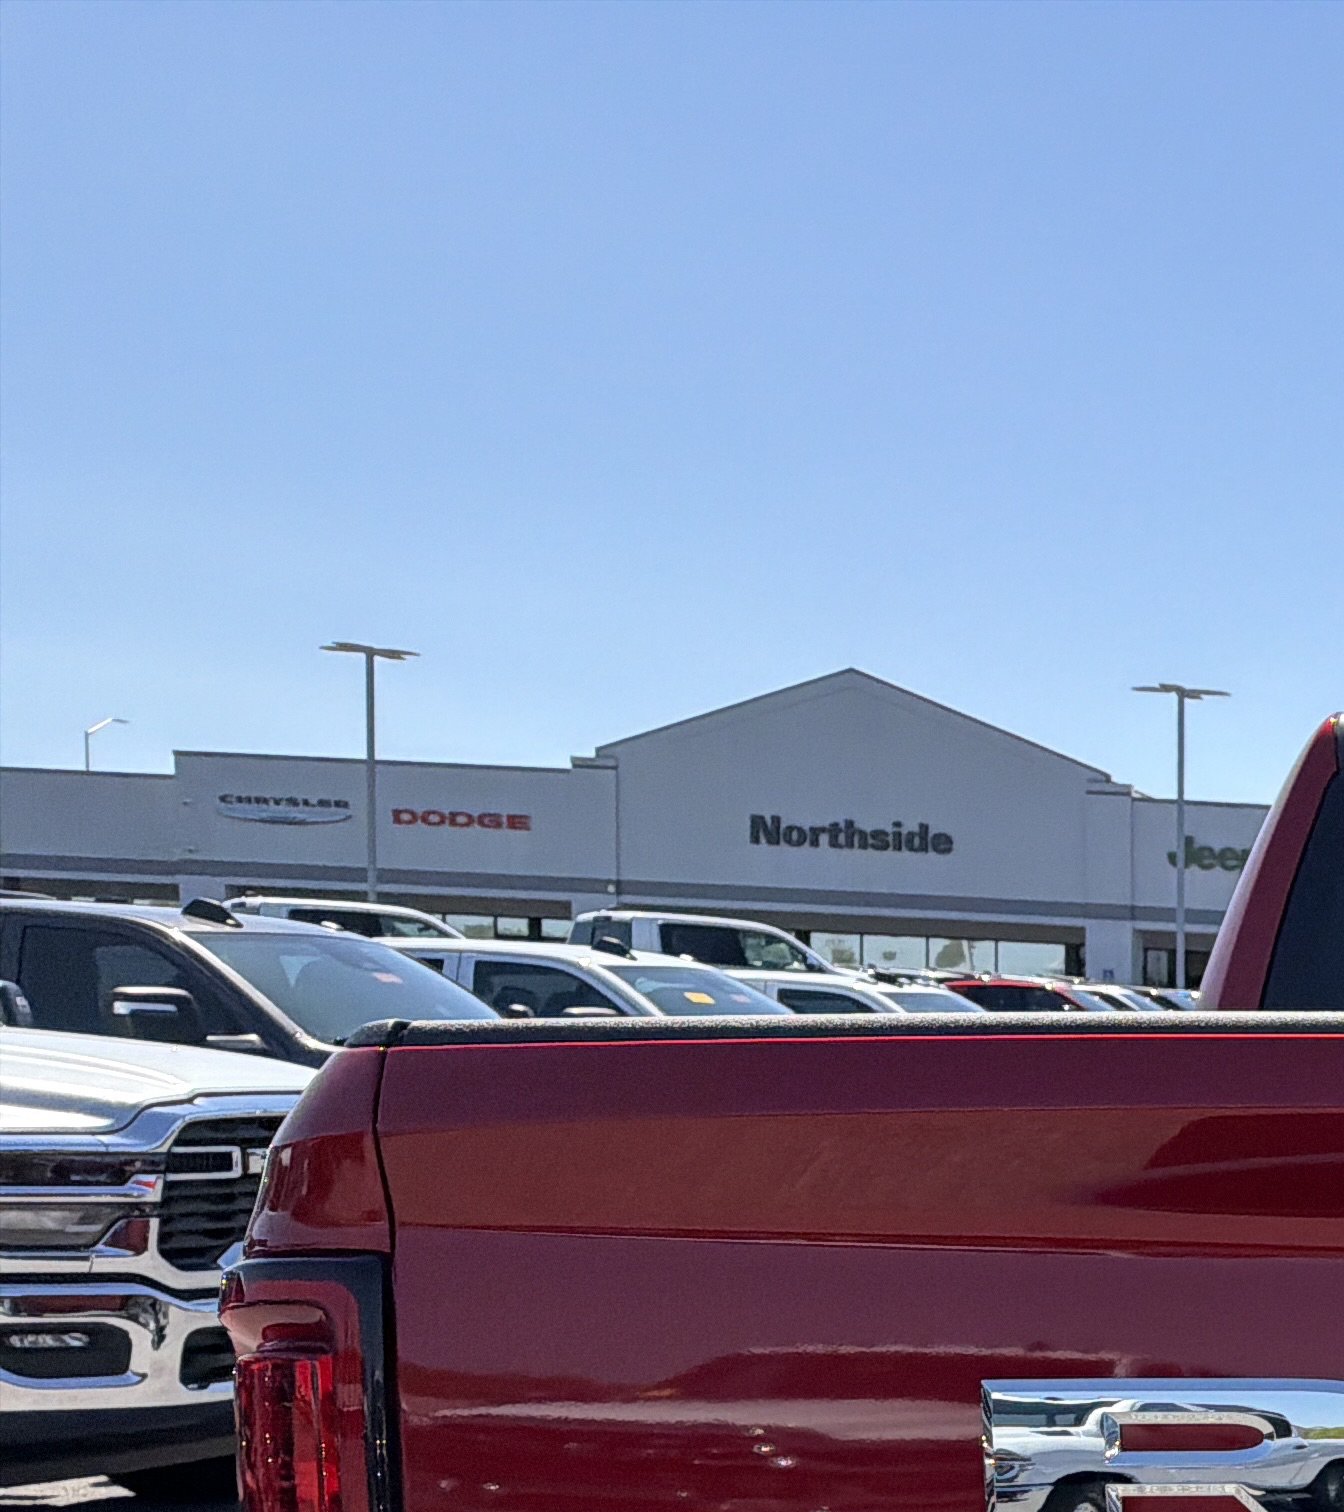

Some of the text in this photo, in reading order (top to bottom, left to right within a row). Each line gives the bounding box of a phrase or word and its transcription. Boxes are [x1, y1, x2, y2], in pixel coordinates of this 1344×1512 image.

[218, 793, 349, 809] CHRYSLER
[391, 808, 532, 831] DODGE
[750, 814, 954, 855] Northside
